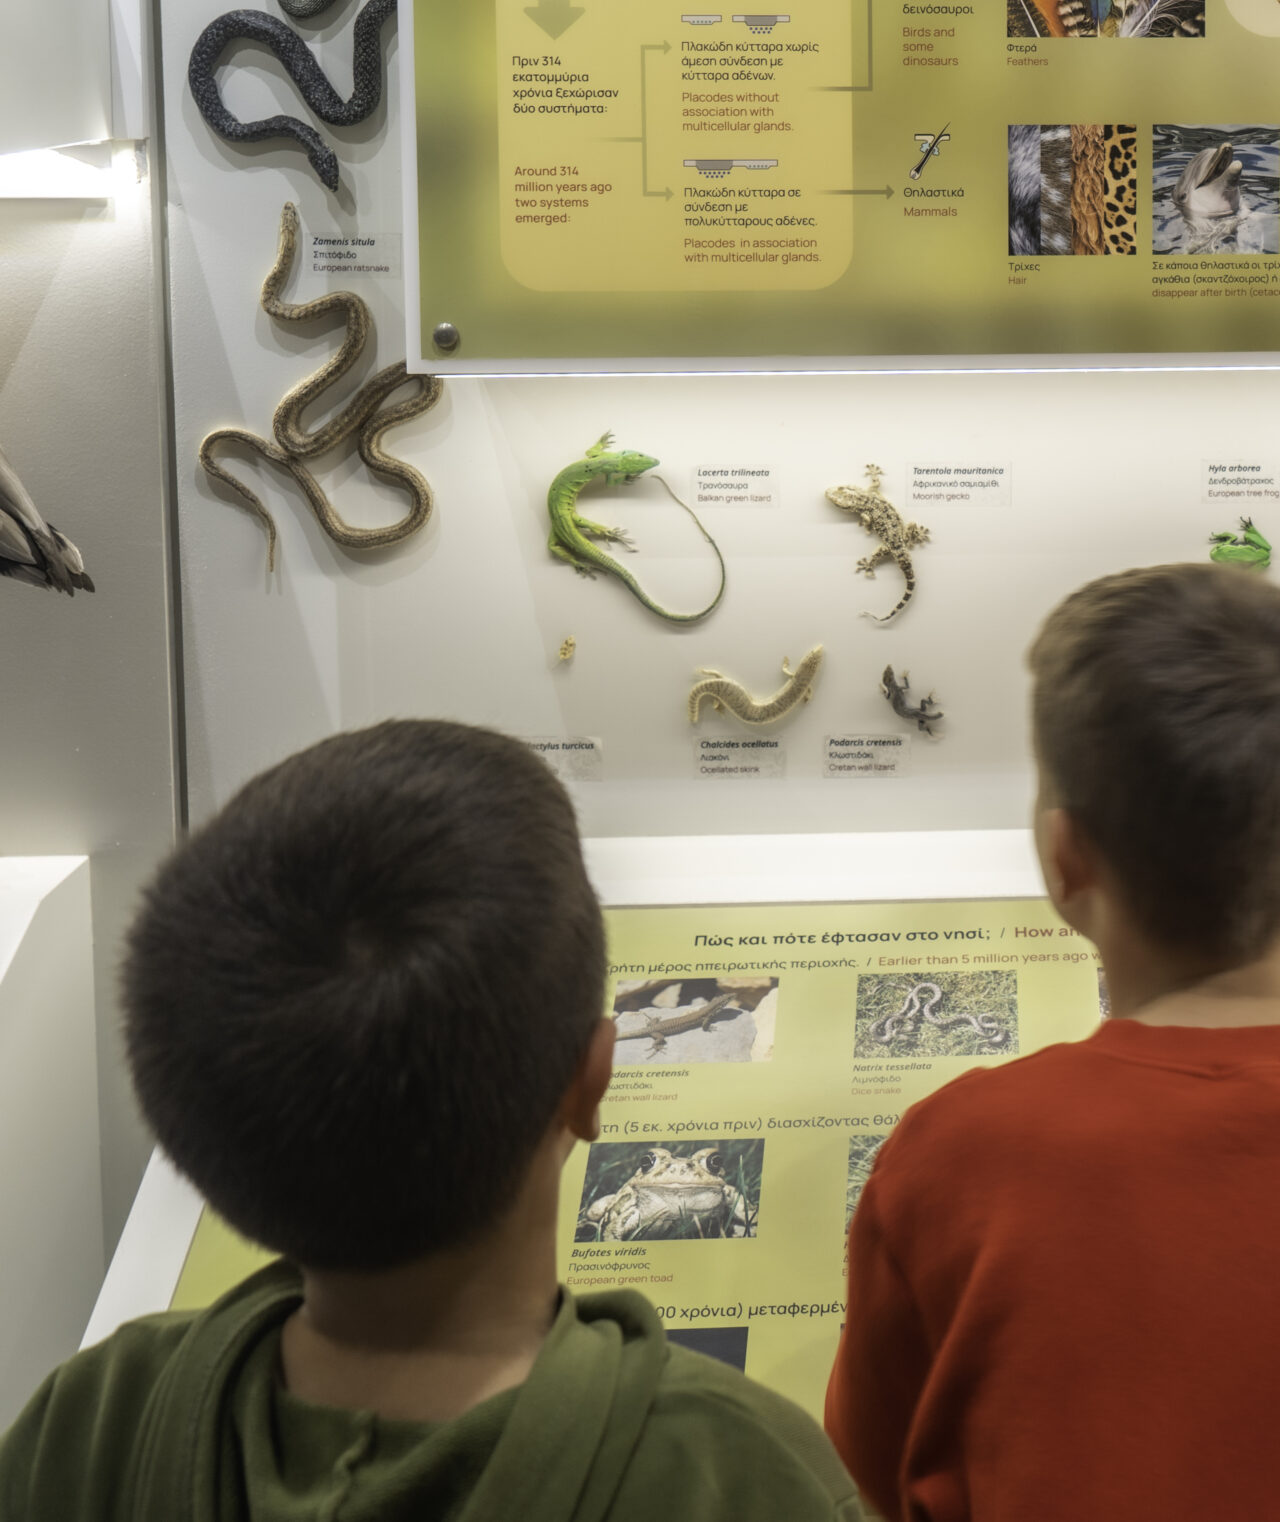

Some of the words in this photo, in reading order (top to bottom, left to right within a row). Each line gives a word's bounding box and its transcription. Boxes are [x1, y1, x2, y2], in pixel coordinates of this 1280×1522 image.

[903, 4, 974, 16] δεινόσαυροι
[903, 27, 931, 37] Birds
[933, 27, 955, 37] and
[681, 41, 733, 53] Πλακώδη
[736, 41, 783, 54] κύτταρα
[786, 41, 819, 54] χωρίς
[903, 42, 934, 51] some
[1007, 44, 1037, 53] Φτερά
[512, 56, 538, 68] Πριν
[541, 57, 561, 66] 314
[681, 55, 715, 68] άμεση
[719, 55, 767, 66] σύνδεση
[770, 58, 783, 68] με
[903, 56, 959, 66] dinosaurs
[1007, 57, 1048, 66] Feathers
[512, 71, 589, 85] εκατομμύρια
[682, 70, 729, 82] κύτταρα
[732, 70, 776, 81] αδένων.
[513, 87, 552, 101] χρόνια
[555, 87, 619, 101] ξεχώρισαν
[682, 92, 734, 103] Placodes
[736, 92, 779, 102] without
[513, 103, 535, 113] δύο
[538, 104, 608, 115] συστήματα:
[682, 106, 747, 117] association
[749, 106, 774, 117] with
[682, 121, 751, 131] multicellular
[753, 121, 794, 133] glands.
[515, 166, 557, 176] Around
[560, 166, 579, 176] 314
[515, 181, 553, 192] million
[556, 183, 588, 194] years
[590, 183, 613, 194] ago
[904, 187, 964, 197] Θηλαστικά
[684, 187, 736, 198] Πλακώδη
[738, 187, 785, 199] κύτταρα
[787, 189, 801, 198] σε
[515, 198, 537, 207] two
[539, 199, 589, 210] systems
[684, 201, 732, 212] σύνδεση
[735, 203, 748, 213] με
[904, 207, 957, 216] Mammals
[515, 213, 571, 225] emerged:
[684, 215, 773, 228] πολυκύτταρους
[775, 215, 818, 227] αδένες.
[351, 238, 375, 246] situla
[684, 238, 735, 248] Placodes
[740, 238, 750, 248] in
[752, 238, 817, 248] association
[684, 252, 709, 262] with
[711, 252, 779, 262] multicellular
[782, 252, 822, 264] glands.
[313, 263, 352, 272] European
[354, 264, 389, 272] ratsnake
[1008, 262, 1040, 272] Τρίχες
[1166, 261, 1198, 270] κάποια
[1201, 261, 1249, 269] θηλαστικά
[1008, 276, 1027, 284] Hair
[1152, 275, 1190, 284] αγκάθια
[1152, 289, 1197, 299] disappear
[1201, 288, 1222, 297] after
[1225, 288, 1247, 296] birth
[913, 467, 951, 475] Tarentola
[954, 467, 1004, 475] mauritanica
[1208, 465, 1226, 473] Hyla
[698, 494, 724, 502] Balkan
[726, 495, 749, 503] green
[750, 494, 771, 502] lizard
[946, 493, 969, 502] gecko
[1208, 490, 1245, 498] European
[1264, 489, 1279, 498] frog
[562, 742, 594, 750] turcicus
[742, 740, 778, 748] ocellatus
[829, 739, 864, 747] Podarcis
[694, 933, 733, 947] Πώς
[738, 934, 767, 945] και
[773, 931, 816, 945] πότε
[821, 932, 900, 946] έφτασαν
[906, 931, 938, 941] στο
[943, 928, 990, 940] νησί;
[1015, 927, 1053, 938] How
[610, 963, 645, 976] ρήτη
[648, 961, 691, 974] μέρος
[695, 958, 787, 973] ηπειρωτικής
[879, 955, 922, 967] Earlier
[927, 955, 958, 965] than
[973, 953, 1019, 964] million
[1022, 953, 1059, 964] years
[1062, 952, 1088, 963] ago
[853, 1064, 882, 1072] Natrix
[885, 1063, 932, 1071] tessellata
[646, 1069, 689, 1077] cretensis
[624, 1121, 639, 1135] (5
[643, 1120, 663, 1132] εκ.
[667, 1118, 719, 1133] χρόνια
[571, 1249, 611, 1259] Bufotes
[614, 1247, 646, 1256] viridis
[566, 1276, 616, 1286] European
[617, 1276, 648, 1285] green
[650, 1274, 673, 1282] toad
[680, 1303, 743, 1321] χρόνια)
